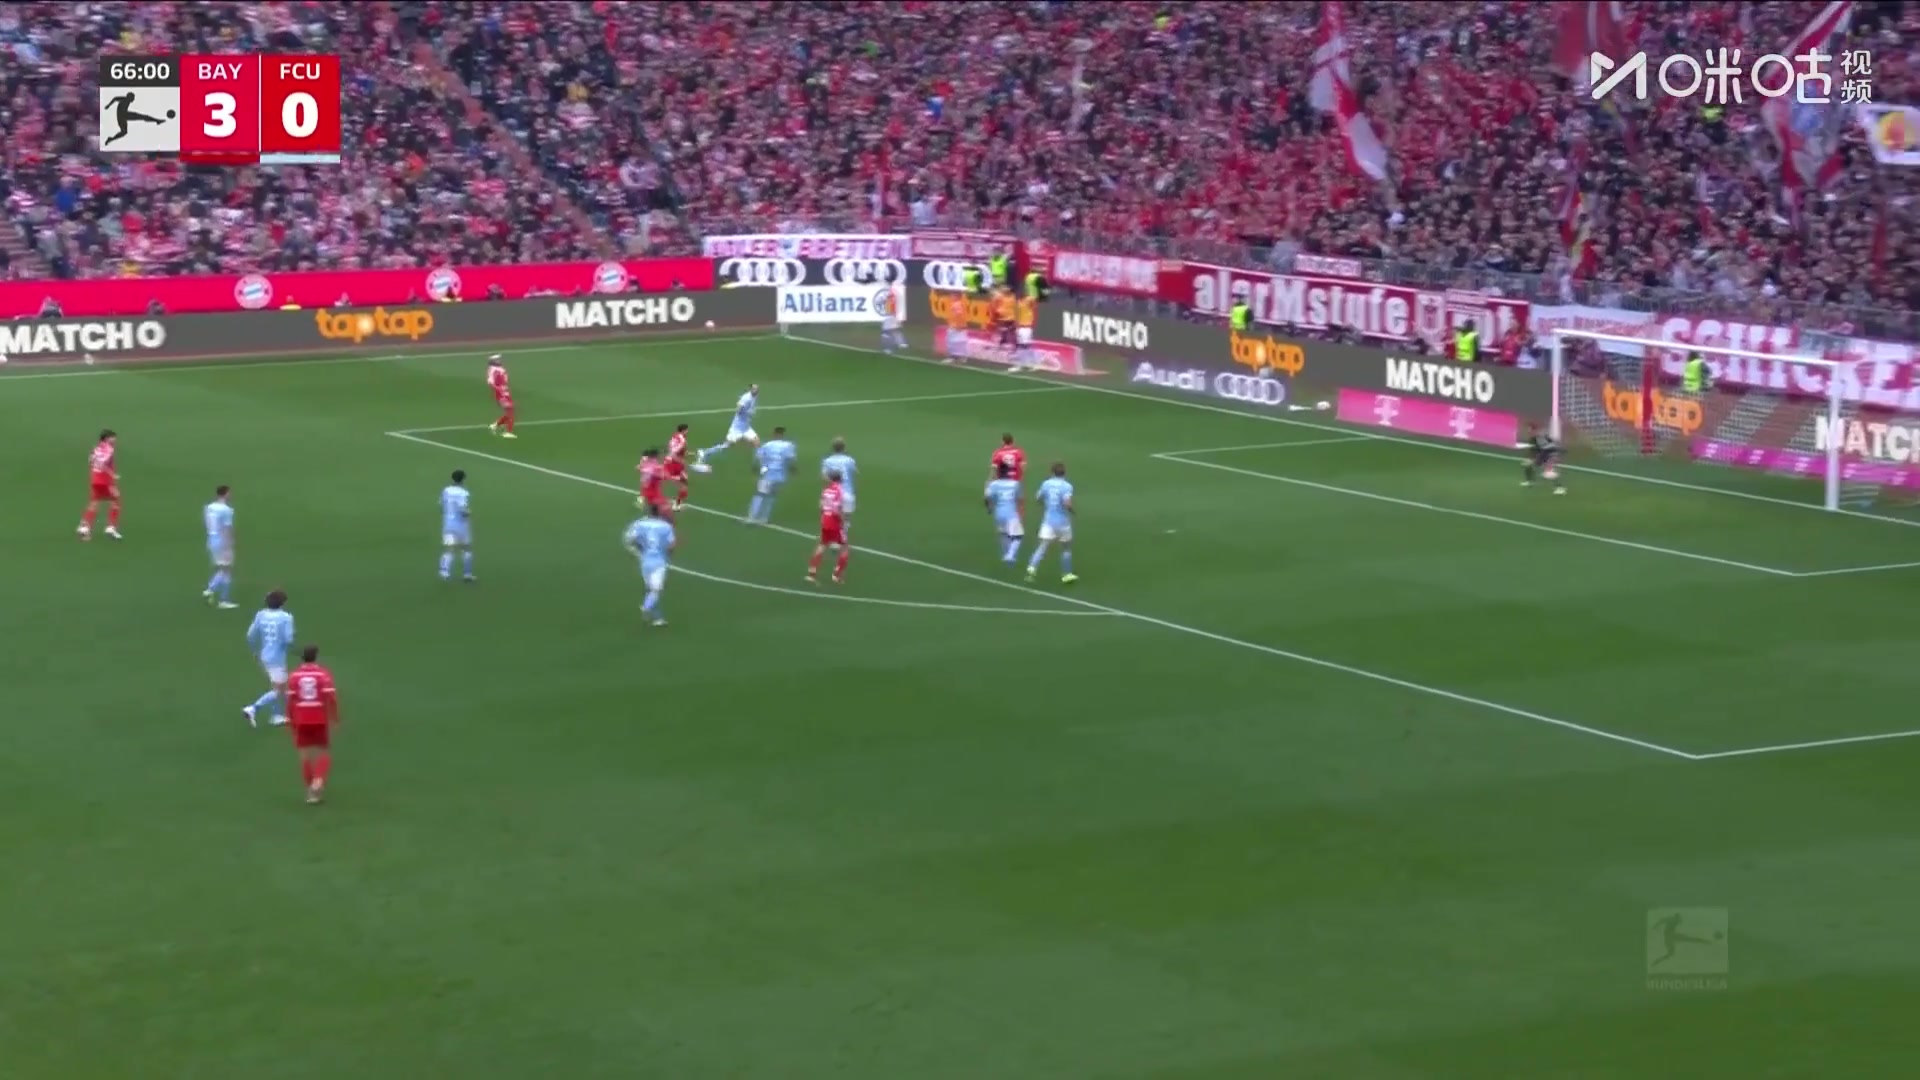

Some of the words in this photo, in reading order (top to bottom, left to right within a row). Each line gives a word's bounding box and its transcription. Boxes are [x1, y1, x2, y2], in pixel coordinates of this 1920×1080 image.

[784, 293, 868, 313] Allianz
[315, 307, 434, 343] taptap
[1230, 330, 1305, 377] taptap
[1132, 361, 1206, 391] Audi
